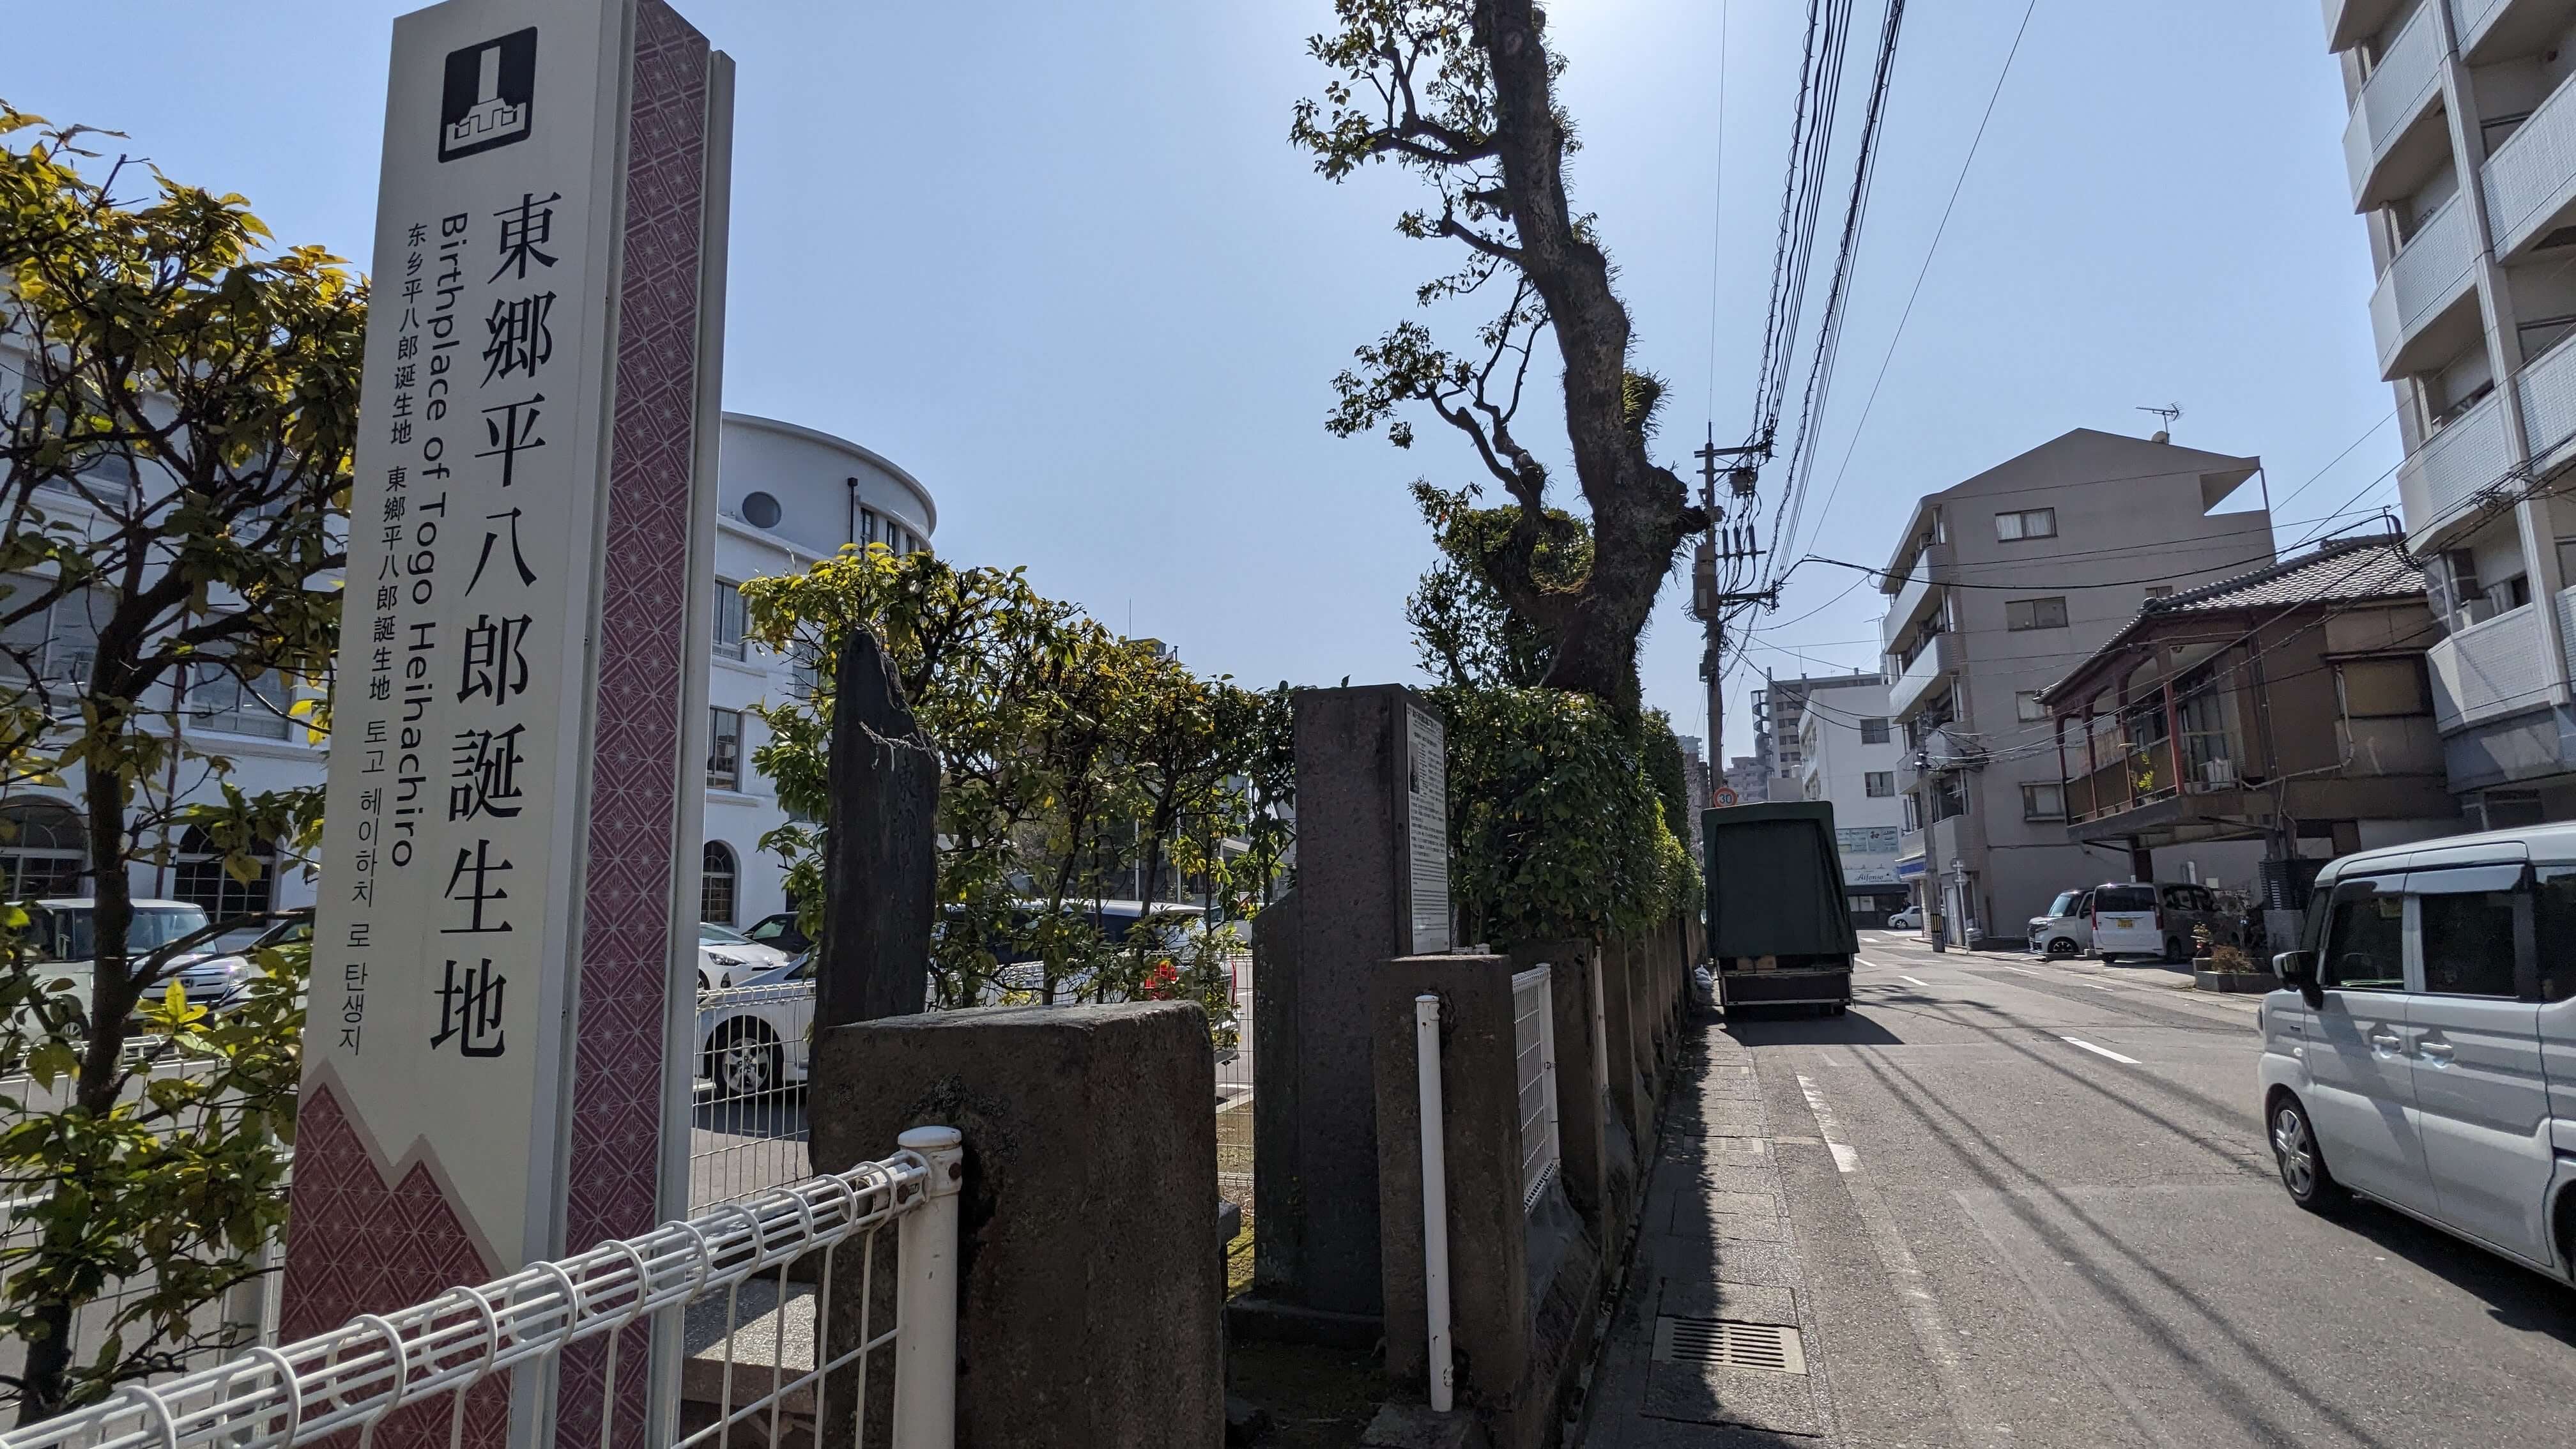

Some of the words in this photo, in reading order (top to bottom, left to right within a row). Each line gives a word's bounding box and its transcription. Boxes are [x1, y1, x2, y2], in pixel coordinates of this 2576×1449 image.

[390, 222, 428, 445] 东乡平八郎诞生地
[427, 212, 468, 421] Birthplace
[422, 436, 450, 480] of
[407, 491, 447, 606] Togo
[430, 191, 562, 1058] 東郷平八郎誕生地
[361, 719, 387, 774] 토고
[391, 622, 436, 868] Heihachiro
[1719, 793, 1733, 804] 30
[338, 962, 369, 1056] 탄생지
